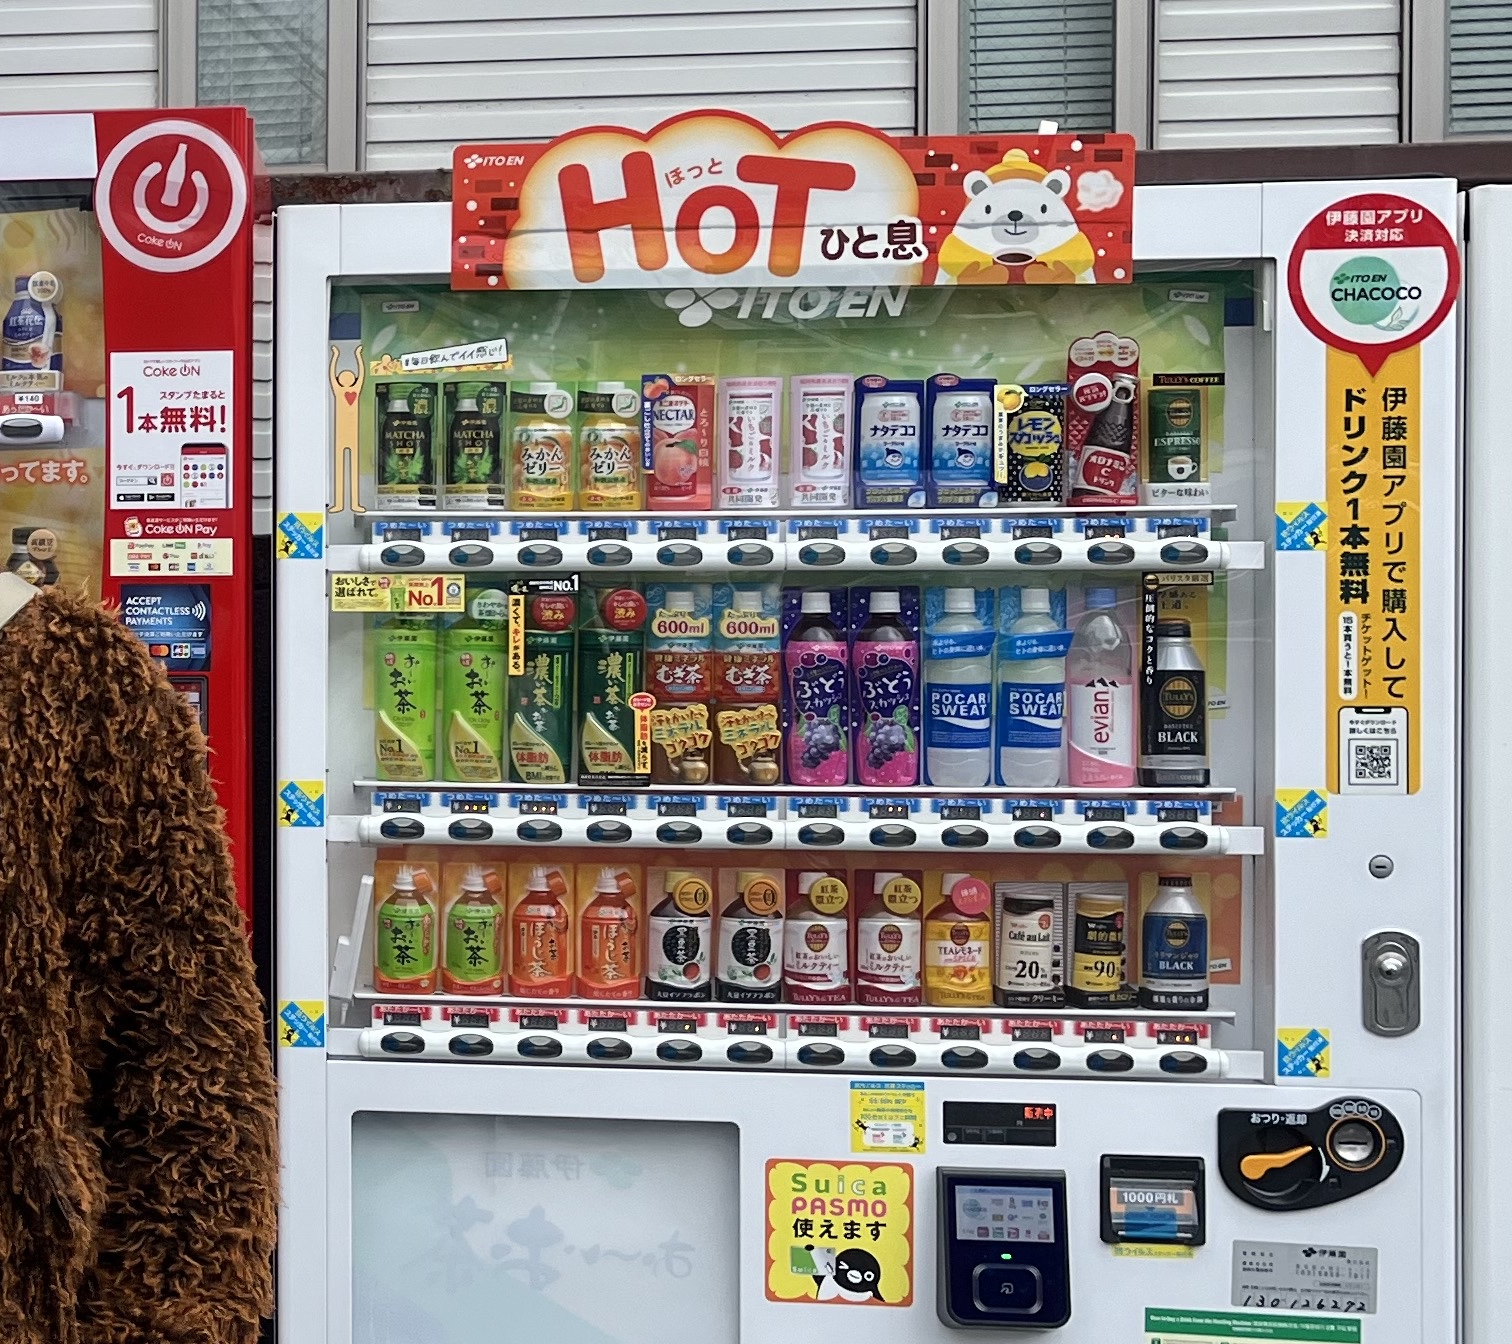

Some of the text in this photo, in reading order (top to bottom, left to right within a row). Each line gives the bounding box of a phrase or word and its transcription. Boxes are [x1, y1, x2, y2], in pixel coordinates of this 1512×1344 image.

[483, 154, 525, 167] ITO EN
[664, 156, 724, 188] ほっと
[1325, 208, 1425, 227] 伊藤園アプリ
[137, 233, 163, 250] Coke
[820, 219, 924, 262] ひと息
[1344, 227, 1405, 243] 決済対応
[1350, 274, 1388, 283] ITO EN
[1331, 286, 1422, 302] CHACOCO
[734, 285, 910, 320] ITO EN
[143, 365, 178, 378] Coke
[1189, 376, 1220, 384] COFFEE
[159, 390, 226, 401] スタンプたまると
[1028, 385, 1069, 393] ロングセラー
[653, 408, 695, 421] NECTAR
[869, 424, 916, 437] ナタデココ
[942, 424, 989, 437] ナタデココ
[1017, 417, 1056, 431] レモン
[385, 430, 425, 439] MATCHA
[453, 430, 494, 439] MATCHA
[1009, 431, 1062, 444] スカッシュ
[521, 447, 563, 462] みかん
[589, 447, 631, 462] みかん
[523, 461, 561, 476] ゼリー
[592, 460, 629, 475] ゼリー
[1338, 387, 1370, 605] ドリンク1本無料
[144, 524, 218, 536] Coke Pay
[1381, 386, 1408, 699] 伊藤園アプリで購入して
[335, 576, 377, 587] おいしさで
[553, 574, 579, 592] NO.1
[334, 586, 379, 598] 選ばれて。
[126, 597, 162, 606] ACCEPT
[126, 607, 190, 616] CONTACTLESS
[541, 610, 565, 621] 渋み
[614, 608, 636, 619] 渋み
[126, 617, 173, 626] PAYMENTS
[657, 620, 704, 634] 600ml
[726, 621, 775, 635] 600ml
[1144, 594, 1155, 686] 圧倒的なコクと香り
[656, 664, 704, 685] むぎ茶
[726, 664, 773, 685] むぎ茶
[389, 667, 417, 715] お茶
[465, 667, 493, 715] お茶
[797, 670, 845, 699] ぶどう
[862, 670, 912, 699] ぶどう
[931, 703, 987, 717] SWEAT
[1090, 689, 1110, 745] evian
[666, 734, 709, 753] ゴクゴク
[736, 734, 778, 754] ゴクゴク
[1157, 731, 1199, 743] BLACK
[379, 739, 403, 754] No.1
[515, 751, 549, 764] 体脂肪
[820, 884, 840, 895] 紅茶
[893, 884, 913, 895] 紅茶
[1008, 930, 1050, 942] Café au Lait
[390, 926, 418, 966] お茶
[463, 926, 489, 966] お茶
[527, 922, 552, 978] ほうじ茶
[602, 923, 625, 979] ほうじ茶
[676, 926, 687, 964] 黒豆茶
[746, 927, 758, 965] 黒豆茶
[938, 946, 982, 956] TEAレモネード
[795, 962, 840, 972] ミルクティー
[869, 963, 912, 973] ミルクティー
[1015, 959, 1039, 978] 20
[1093, 960, 1115, 978] 90
[1158, 960, 1193, 971] BLACK
[656, 991, 706, 1000] 大豆イソフラボン
[726, 991, 776, 1000] 大豆イソフラボン
[1024, 1106, 1054, 1120] 販売中
[790, 1172, 887, 1196] Suica
[1122, 1192, 1179, 1204] 1000円札
[791, 1197, 888, 1218] PASMO
[792, 1218, 888, 1242] 使えます
